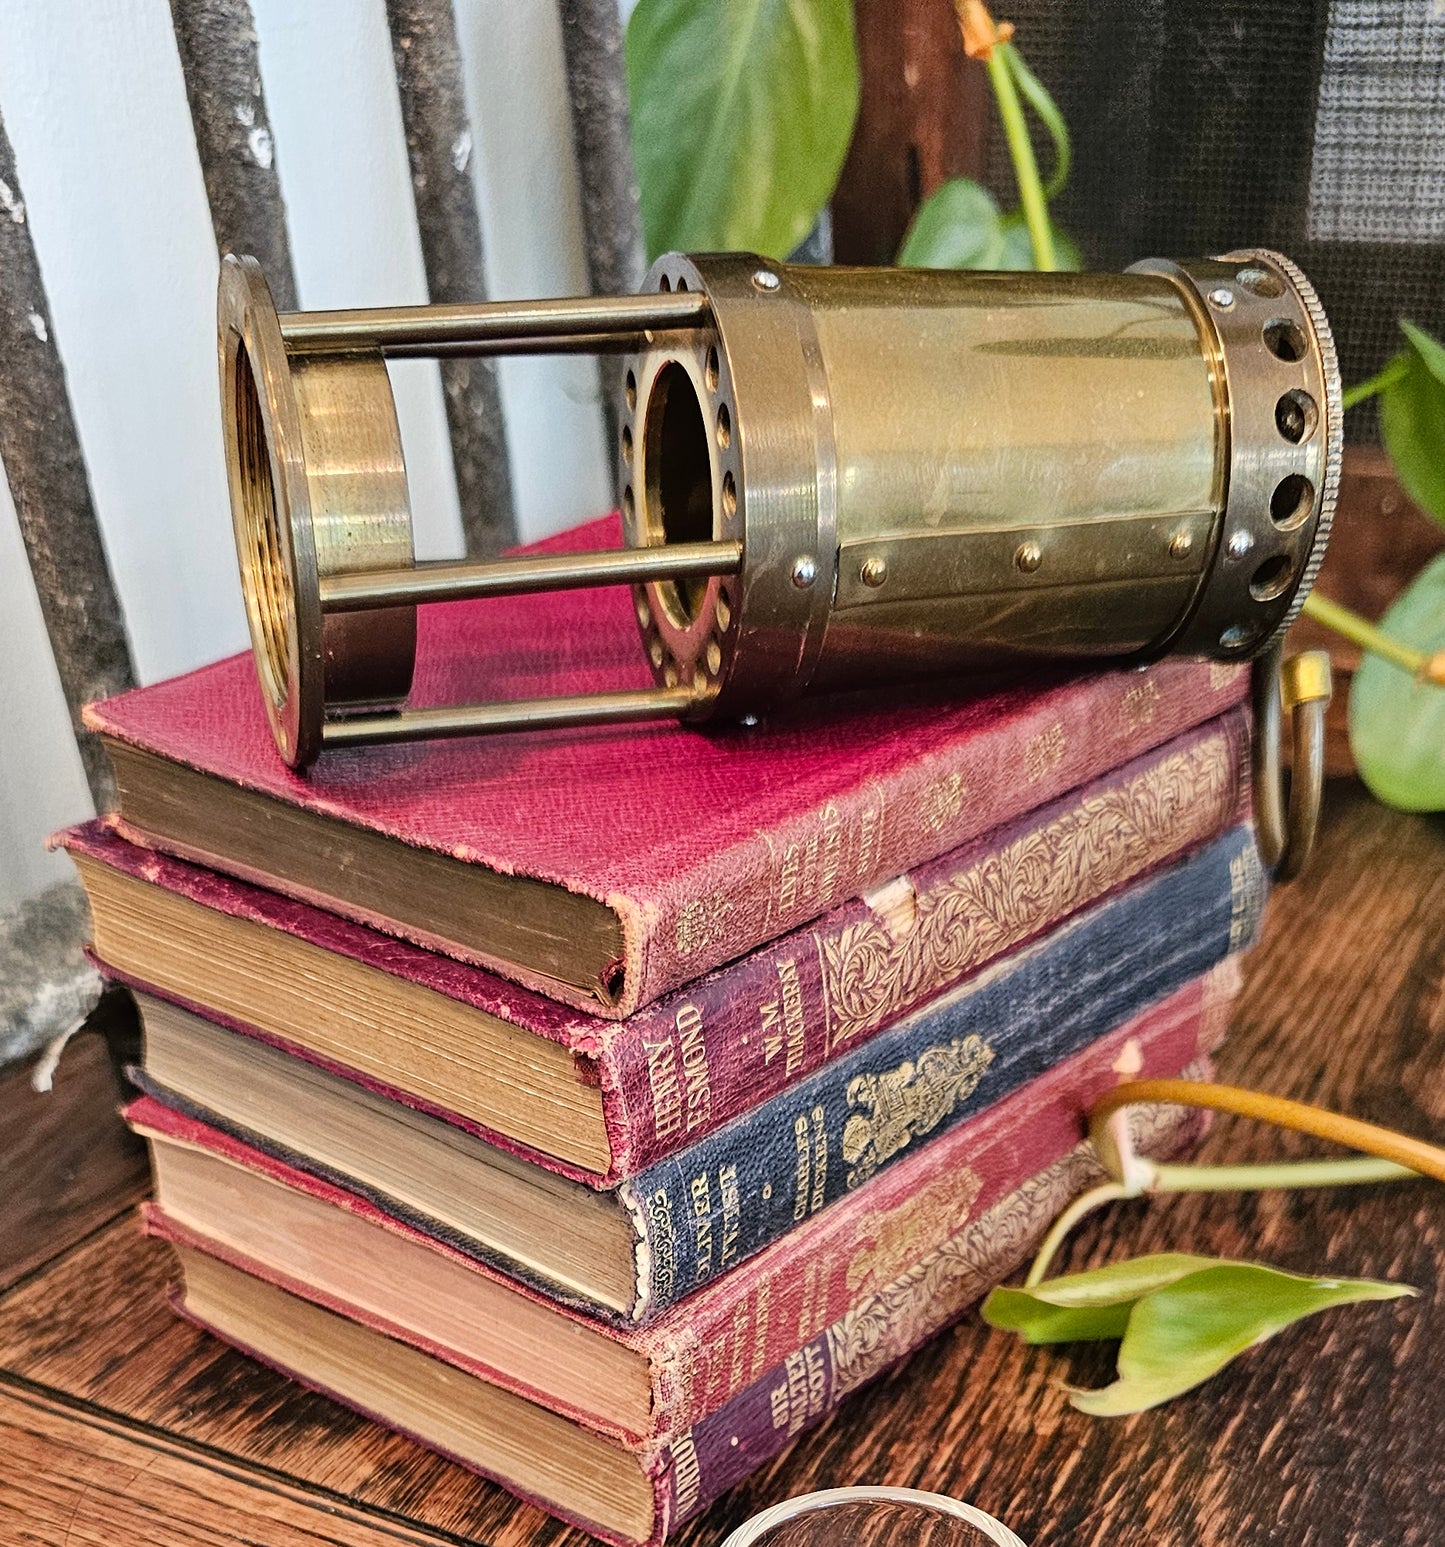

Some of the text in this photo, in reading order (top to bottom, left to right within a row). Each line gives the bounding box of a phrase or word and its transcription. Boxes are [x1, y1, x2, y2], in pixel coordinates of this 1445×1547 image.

[778, 842, 798, 914] LIVES
[678, 1002, 711, 1132] ESMOND
[776, 957, 804, 1077] THACKERAY
[642, 1033, 682, 1140] HENRY
[793, 1116, 809, 1221] CHARLES
[810, 1105, 827, 1213] DICKENS
[691, 1172, 712, 1283] OLIVER
[719, 1164, 740, 1265] TWIST
[770, 1381, 789, 1430] SIR
[804, 1343, 825, 1418] SCOTT
